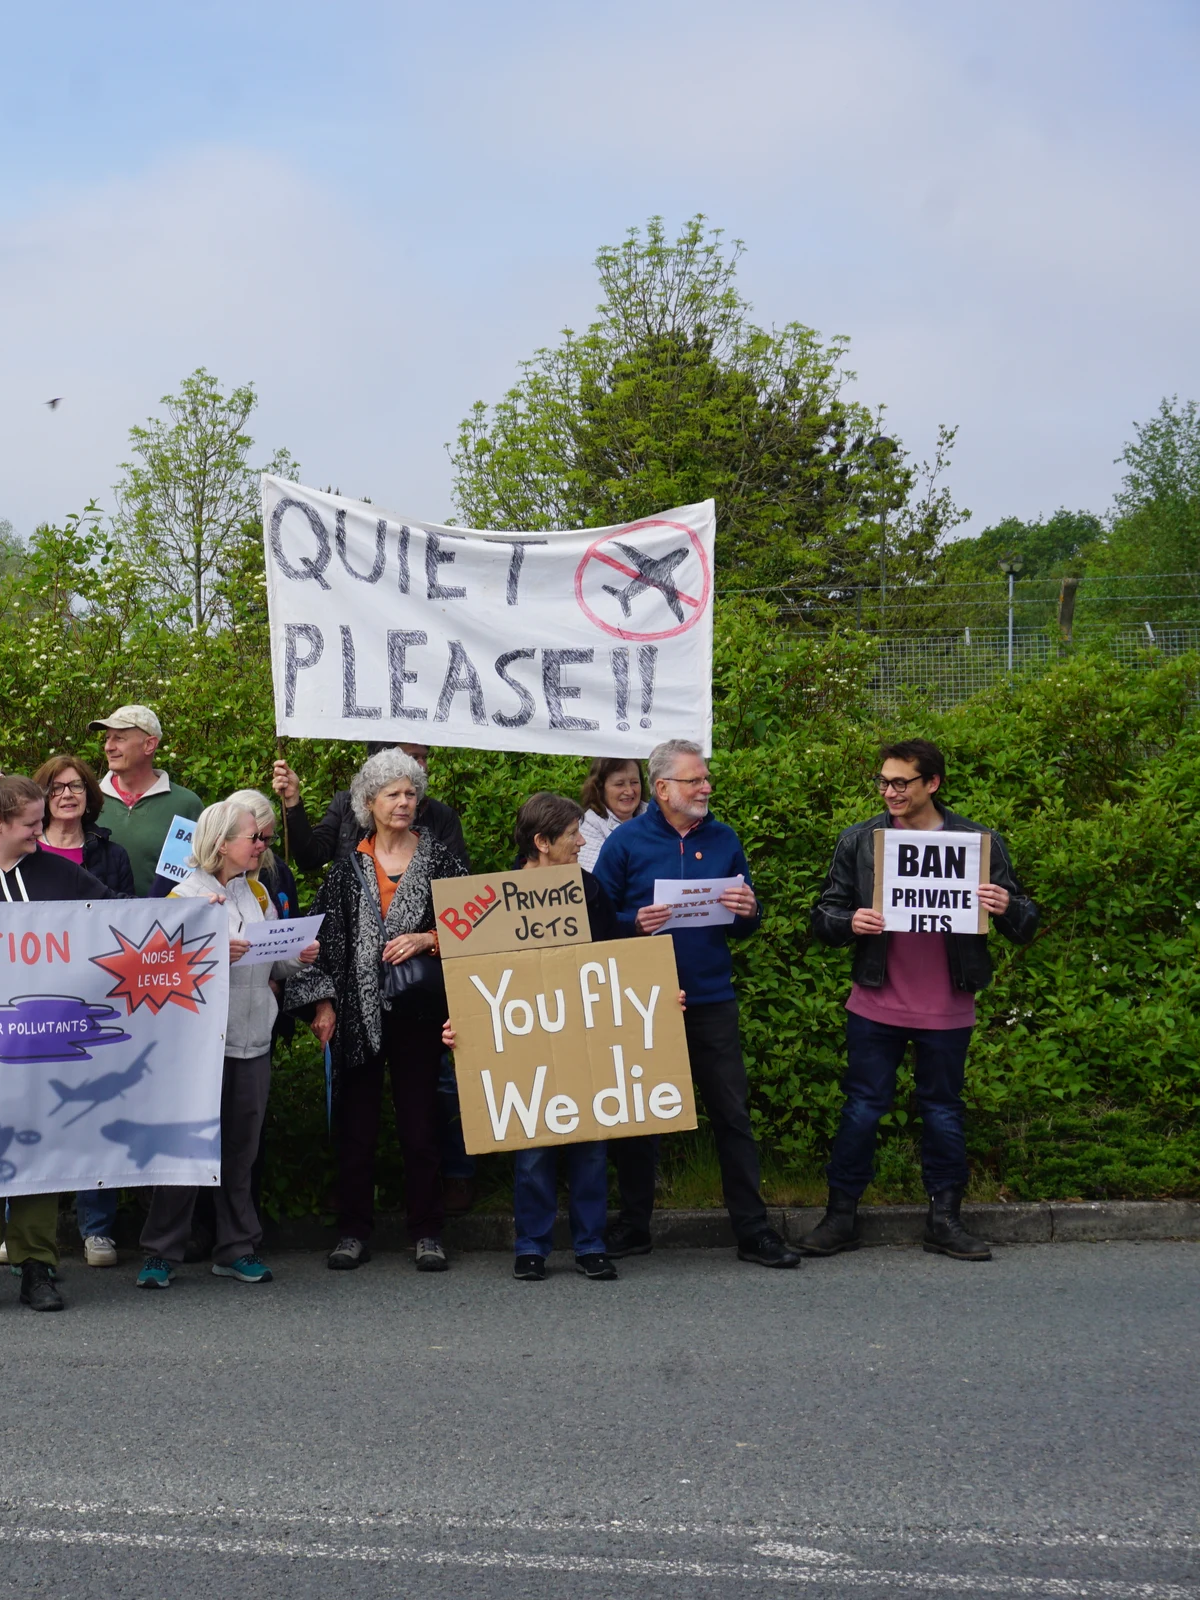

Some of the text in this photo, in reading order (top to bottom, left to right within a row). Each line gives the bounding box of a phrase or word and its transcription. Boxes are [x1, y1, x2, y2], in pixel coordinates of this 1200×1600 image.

[269, 497, 549, 606] QUIET
[283, 622, 659, 732] PLEASE!!
[175, 828, 193, 843] BA
[898, 844, 966, 879] BAN
[681, 887, 712, 895] BAN
[891, 888, 972, 909] PRIVATE
[438, 880, 583, 942] BAN PRIVATE
[268, 926, 295, 935] BAN
[909, 914, 952, 933] JETS
[249, 935, 305, 949] PRIVATE
[141, 949, 176, 965] NOISE
[137, 972, 182, 988] LEVELS
[469, 957, 661, 1054] You fly
[8, 1018, 88, 1036] POLLUTANTS
[480, 1045, 682, 1142] We die
